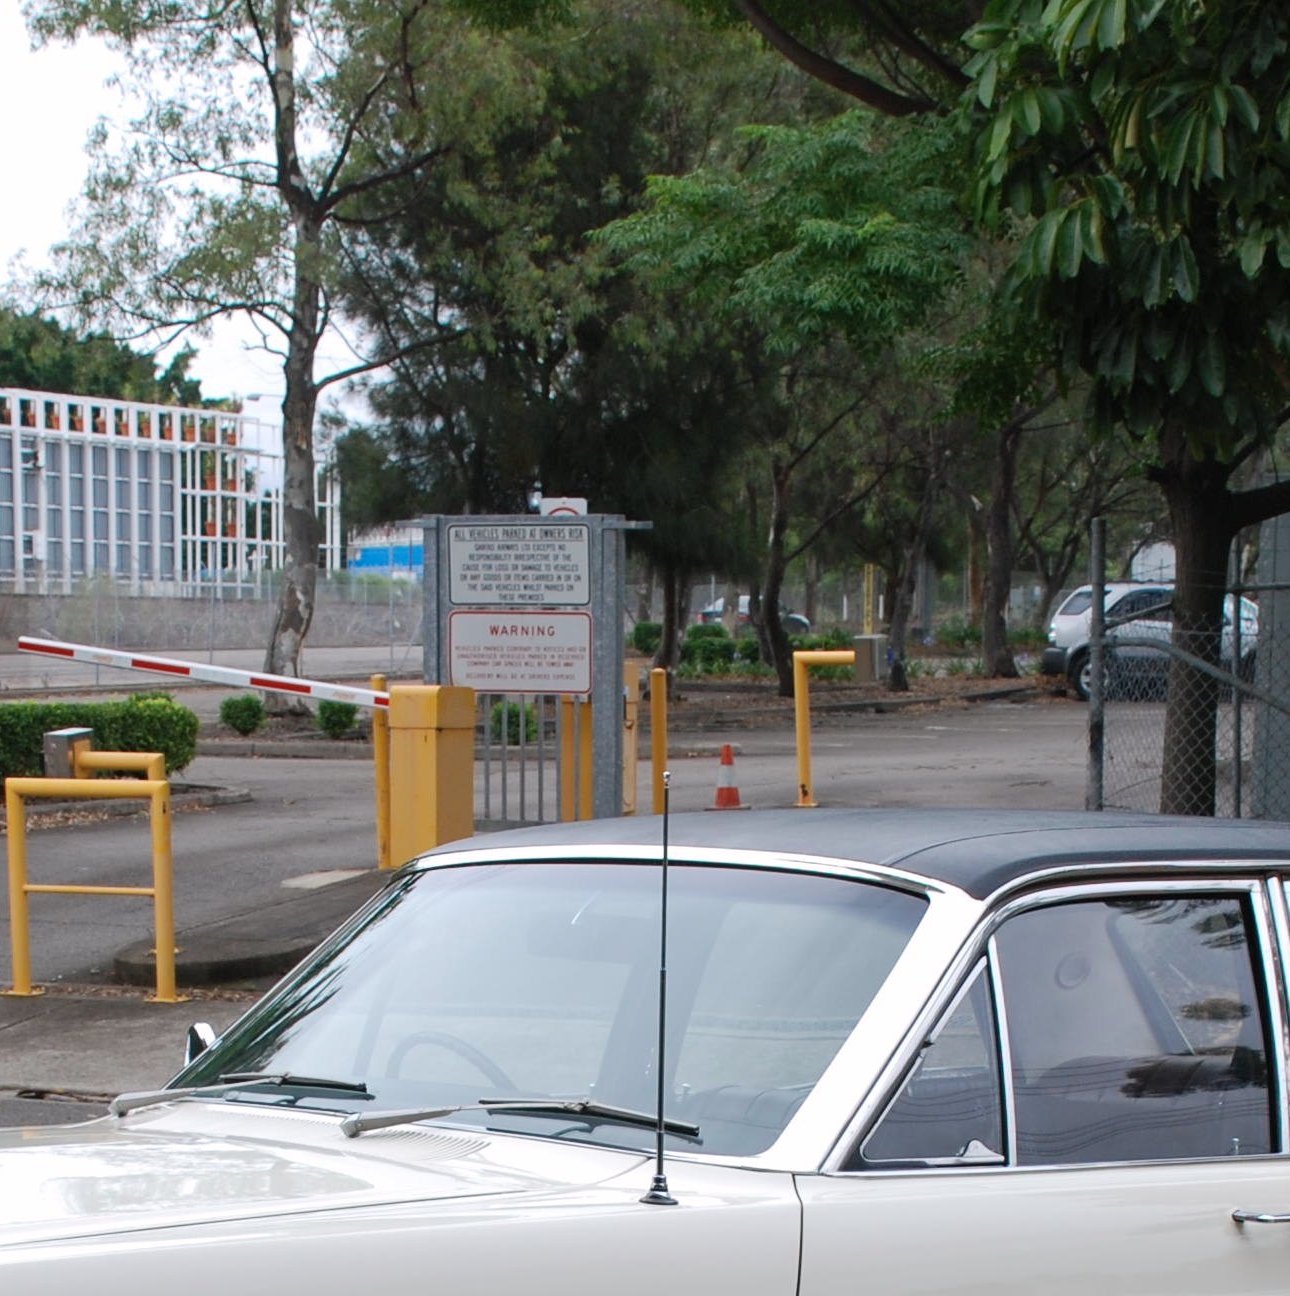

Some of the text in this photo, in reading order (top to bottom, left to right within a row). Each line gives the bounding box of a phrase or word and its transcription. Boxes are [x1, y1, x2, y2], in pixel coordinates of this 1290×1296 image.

[454, 528, 584, 539] ALL VEHICLES PARKED AT OWNERS RISK
[489, 625, 556, 637] WARNING
